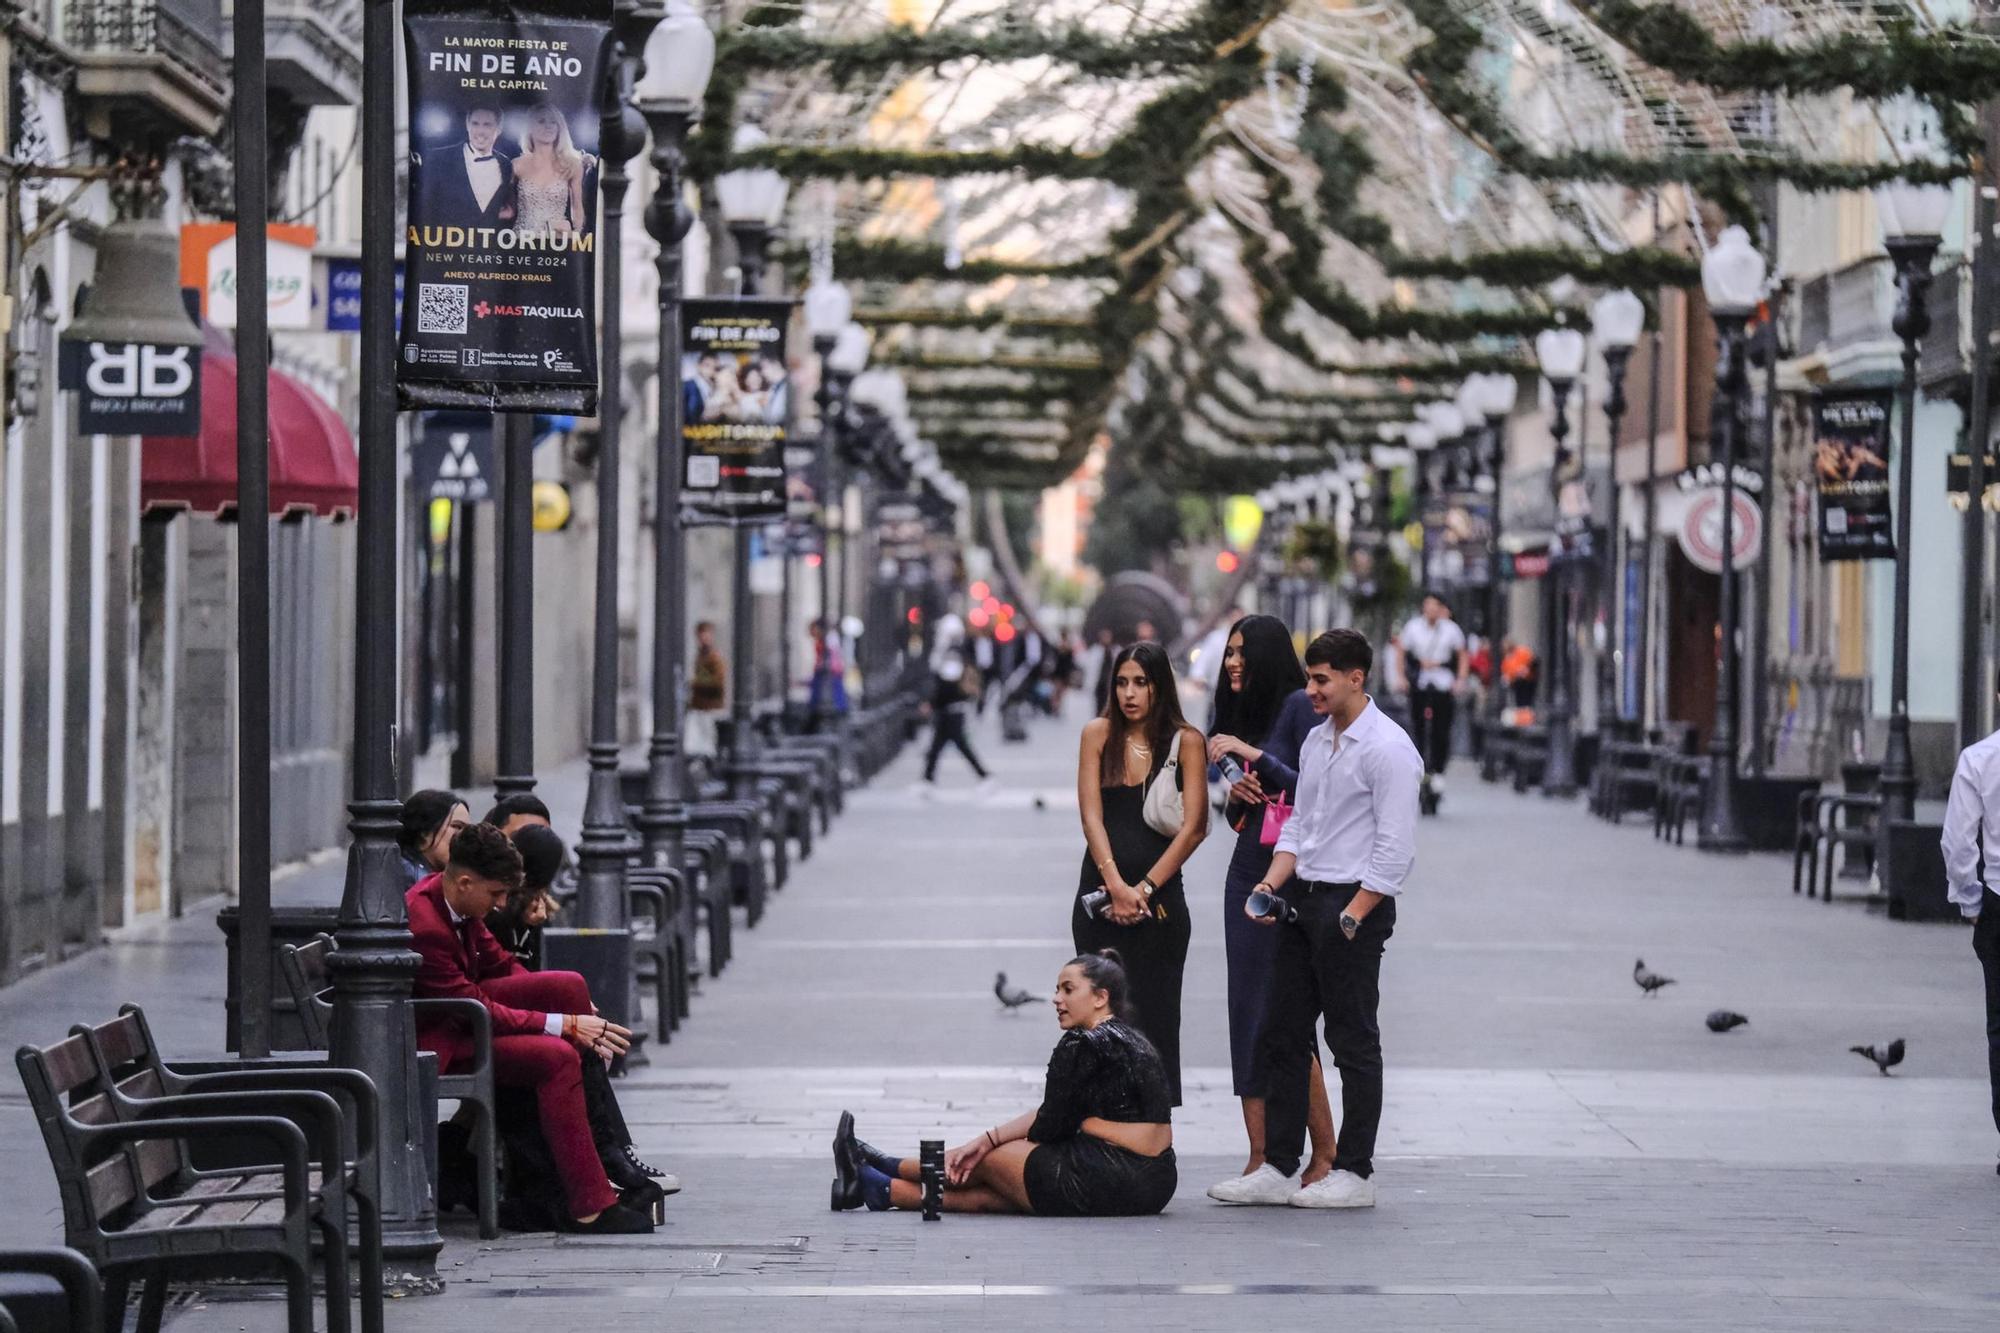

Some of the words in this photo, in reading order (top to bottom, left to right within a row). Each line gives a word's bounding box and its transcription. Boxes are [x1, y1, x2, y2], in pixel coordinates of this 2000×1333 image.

[444, 37, 460, 46] LA
[463, 38, 505, 48] MAYOR
[508, 39, 548, 50] FIESTA
[551, 41, 568, 51] DE
[429, 52, 472, 72] FIN
[481, 54, 516, 74] DE
[524, 52, 582, 77] AÑO
[461, 78, 477, 88] DE
[480, 79, 495, 89] LA
[499, 80, 548, 90] CAPITAL
[407, 225, 593, 253] AUDITORIUM
[426, 252, 454, 263] NEW
[460, 254, 503, 265] YEAR'S
[508, 256, 531, 266] EVE
[537, 257, 567, 267] 2024
[443, 271, 476, 280] ANEXO
[477, 272, 520, 281] ALFREDO
[521, 273, 552, 282] KRAUS
[494, 305, 584, 319] MASTAQUILLA
